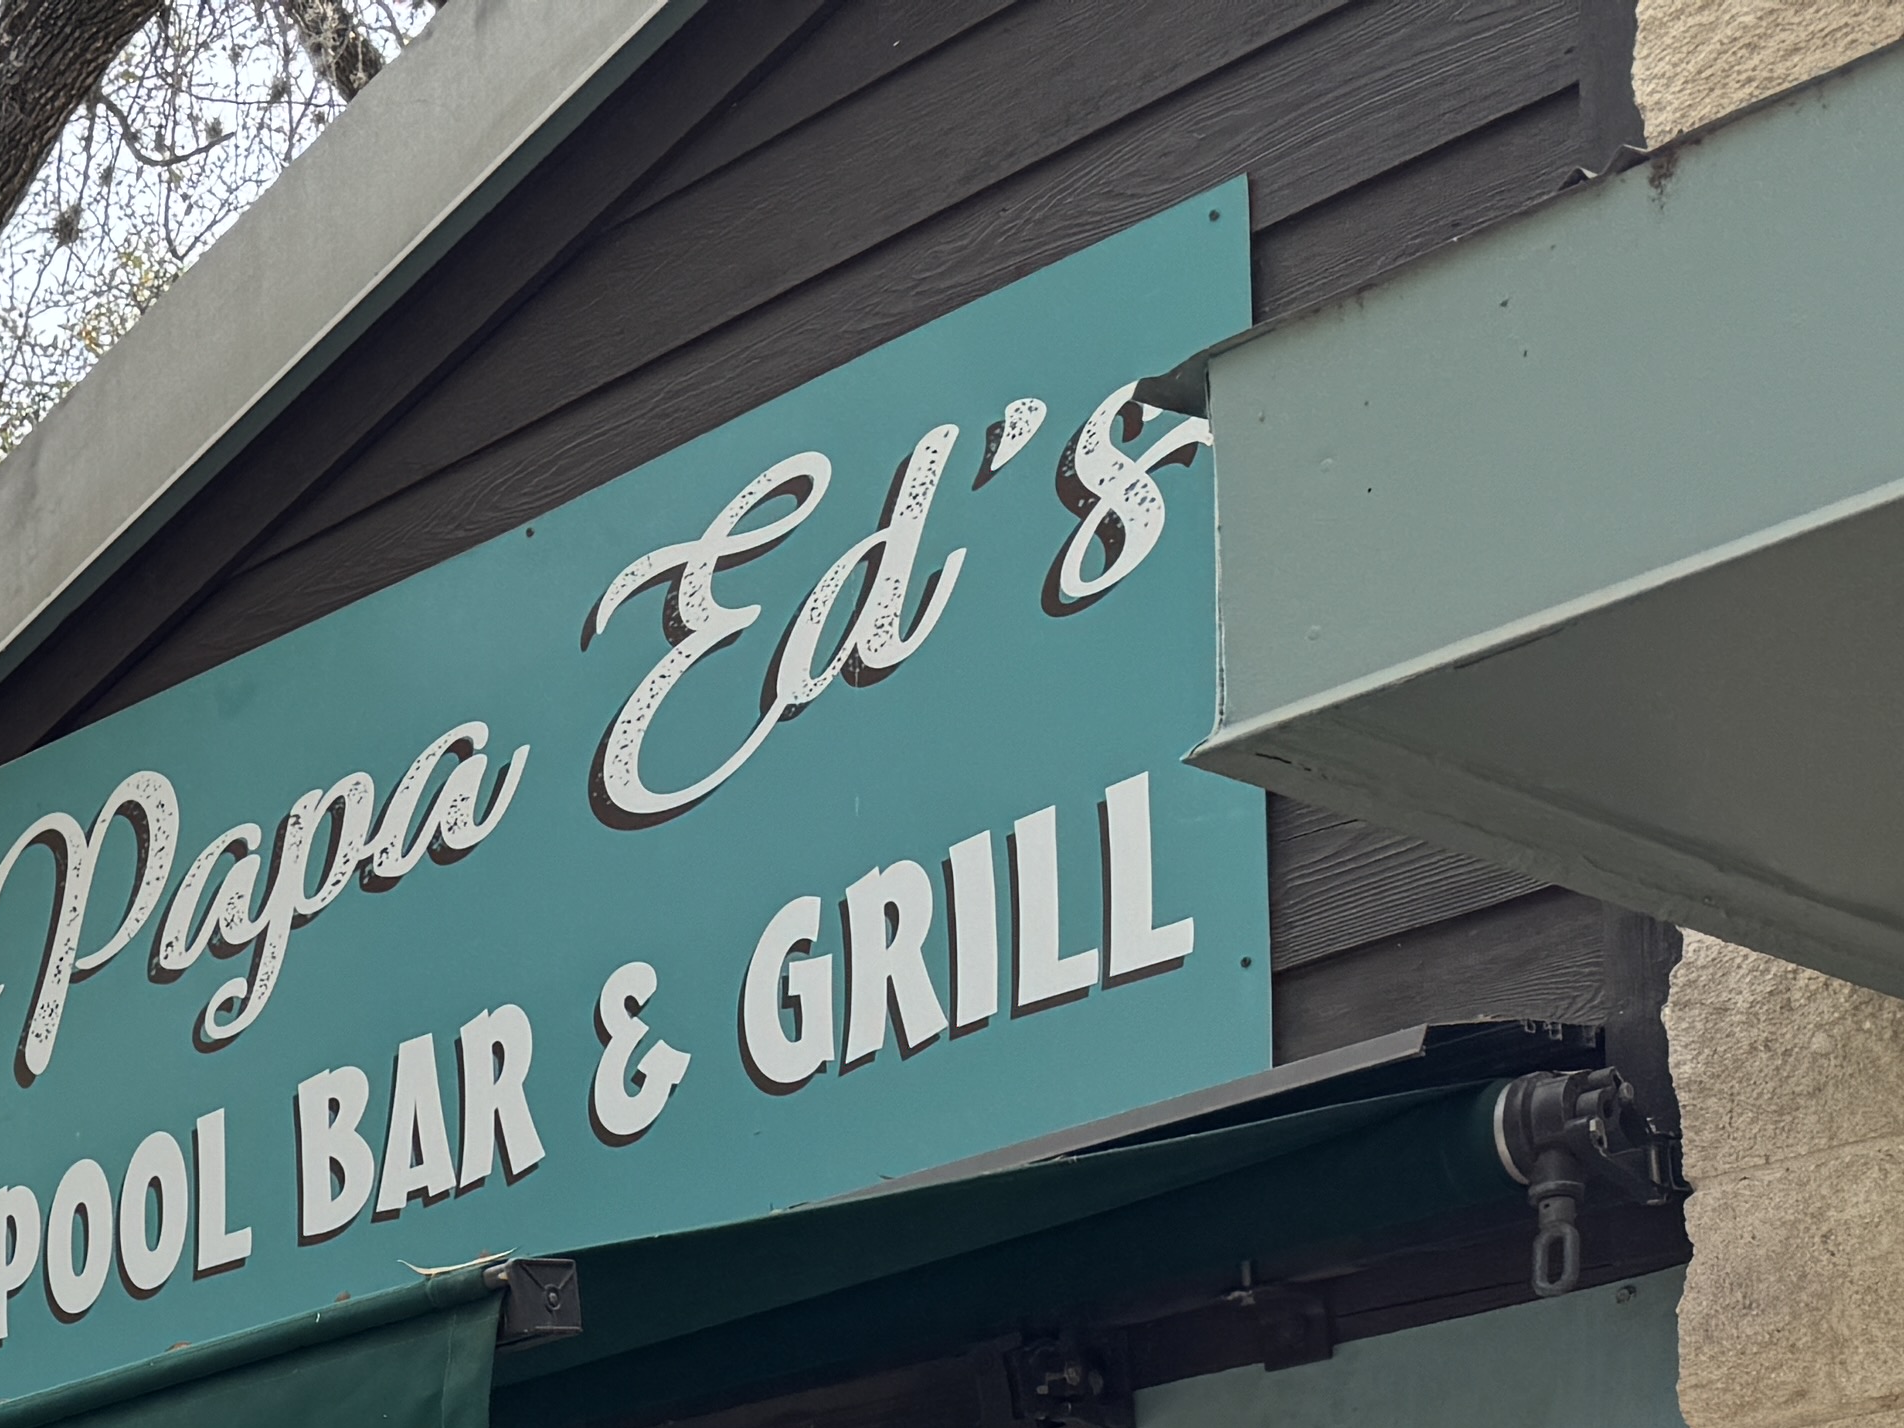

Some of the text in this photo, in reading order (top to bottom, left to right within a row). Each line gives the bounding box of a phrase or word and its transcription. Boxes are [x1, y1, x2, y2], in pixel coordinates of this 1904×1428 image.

[590, 378, 1214, 816] Ed's
[298, 1001, 548, 1240] BAR
[593, 960, 691, 1138] &
[742, 770, 1194, 1088] GRILL
